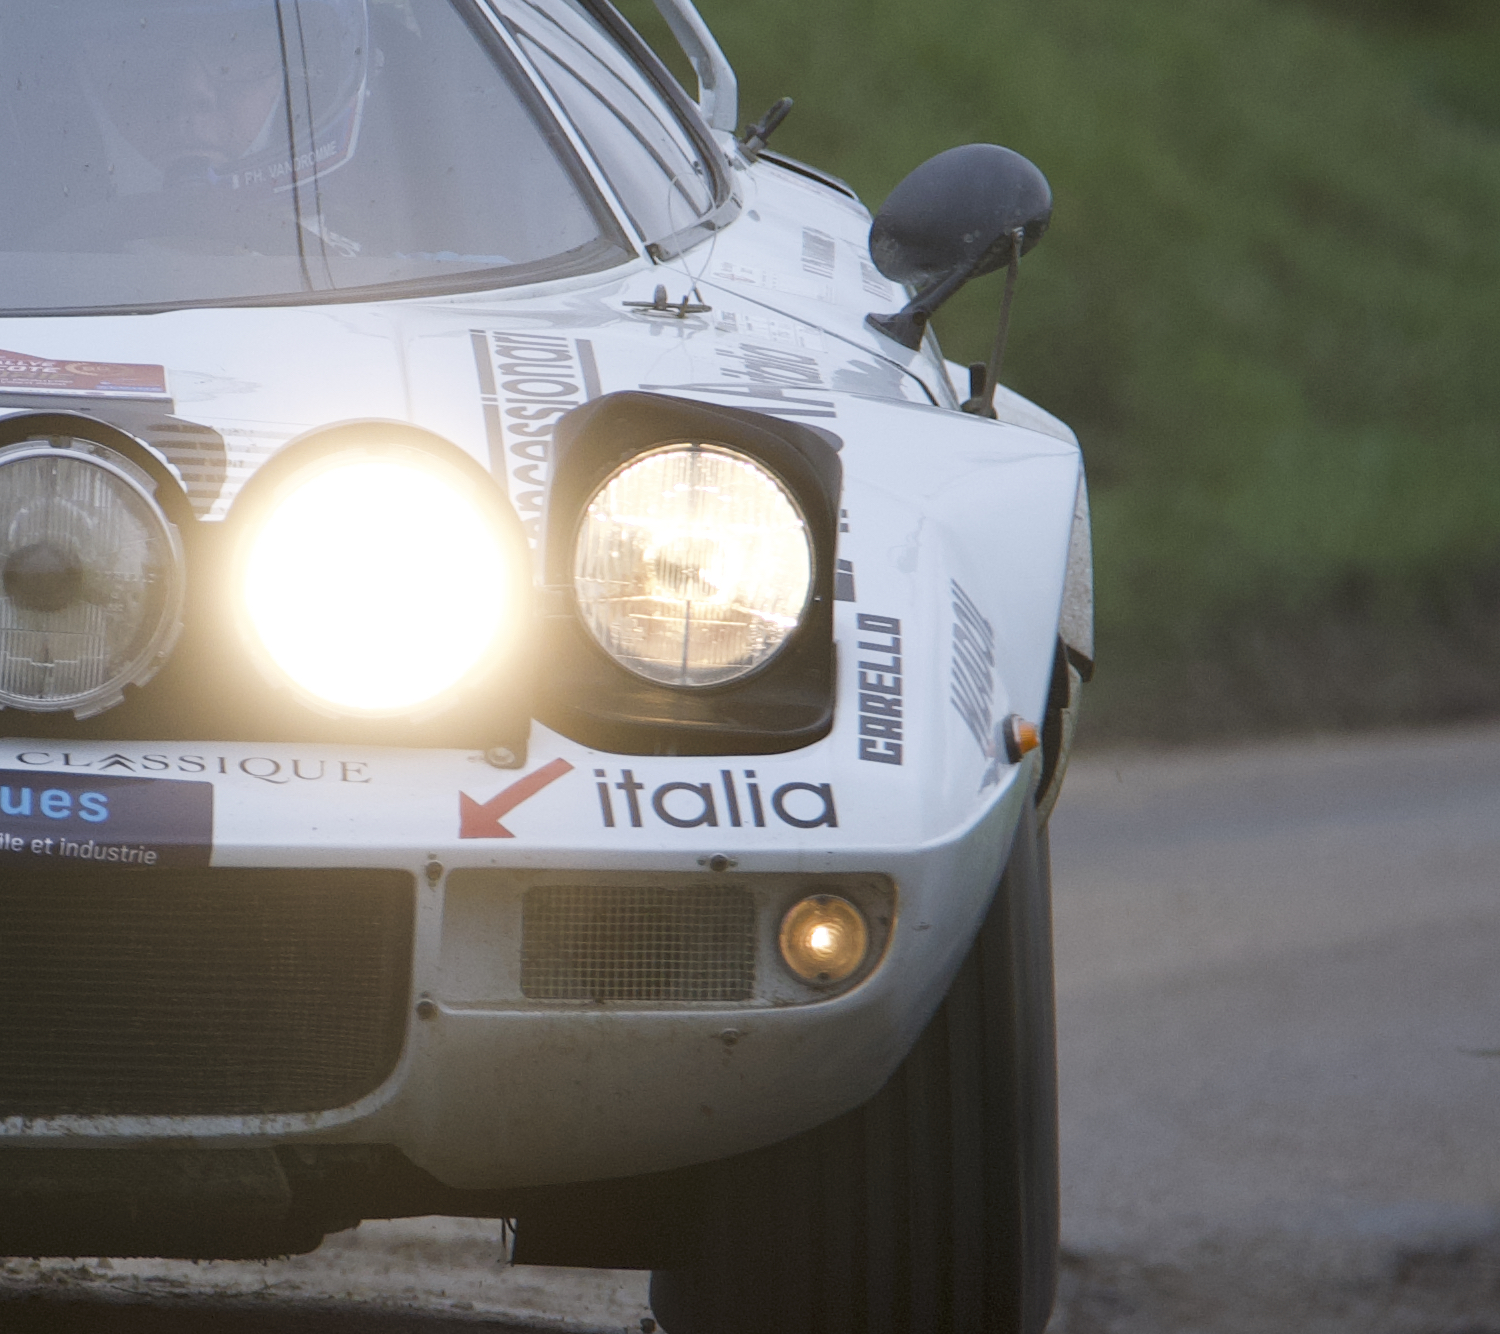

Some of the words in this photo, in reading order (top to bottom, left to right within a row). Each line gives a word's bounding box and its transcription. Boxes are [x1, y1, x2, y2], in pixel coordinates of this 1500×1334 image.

[856, 613, 903, 766] CARELLO
[15, 751, 373, 785] CLASSIQUE
[594, 768, 840, 829] italia
[30, 837, 53, 856] et
[59, 837, 158, 865] industrie
